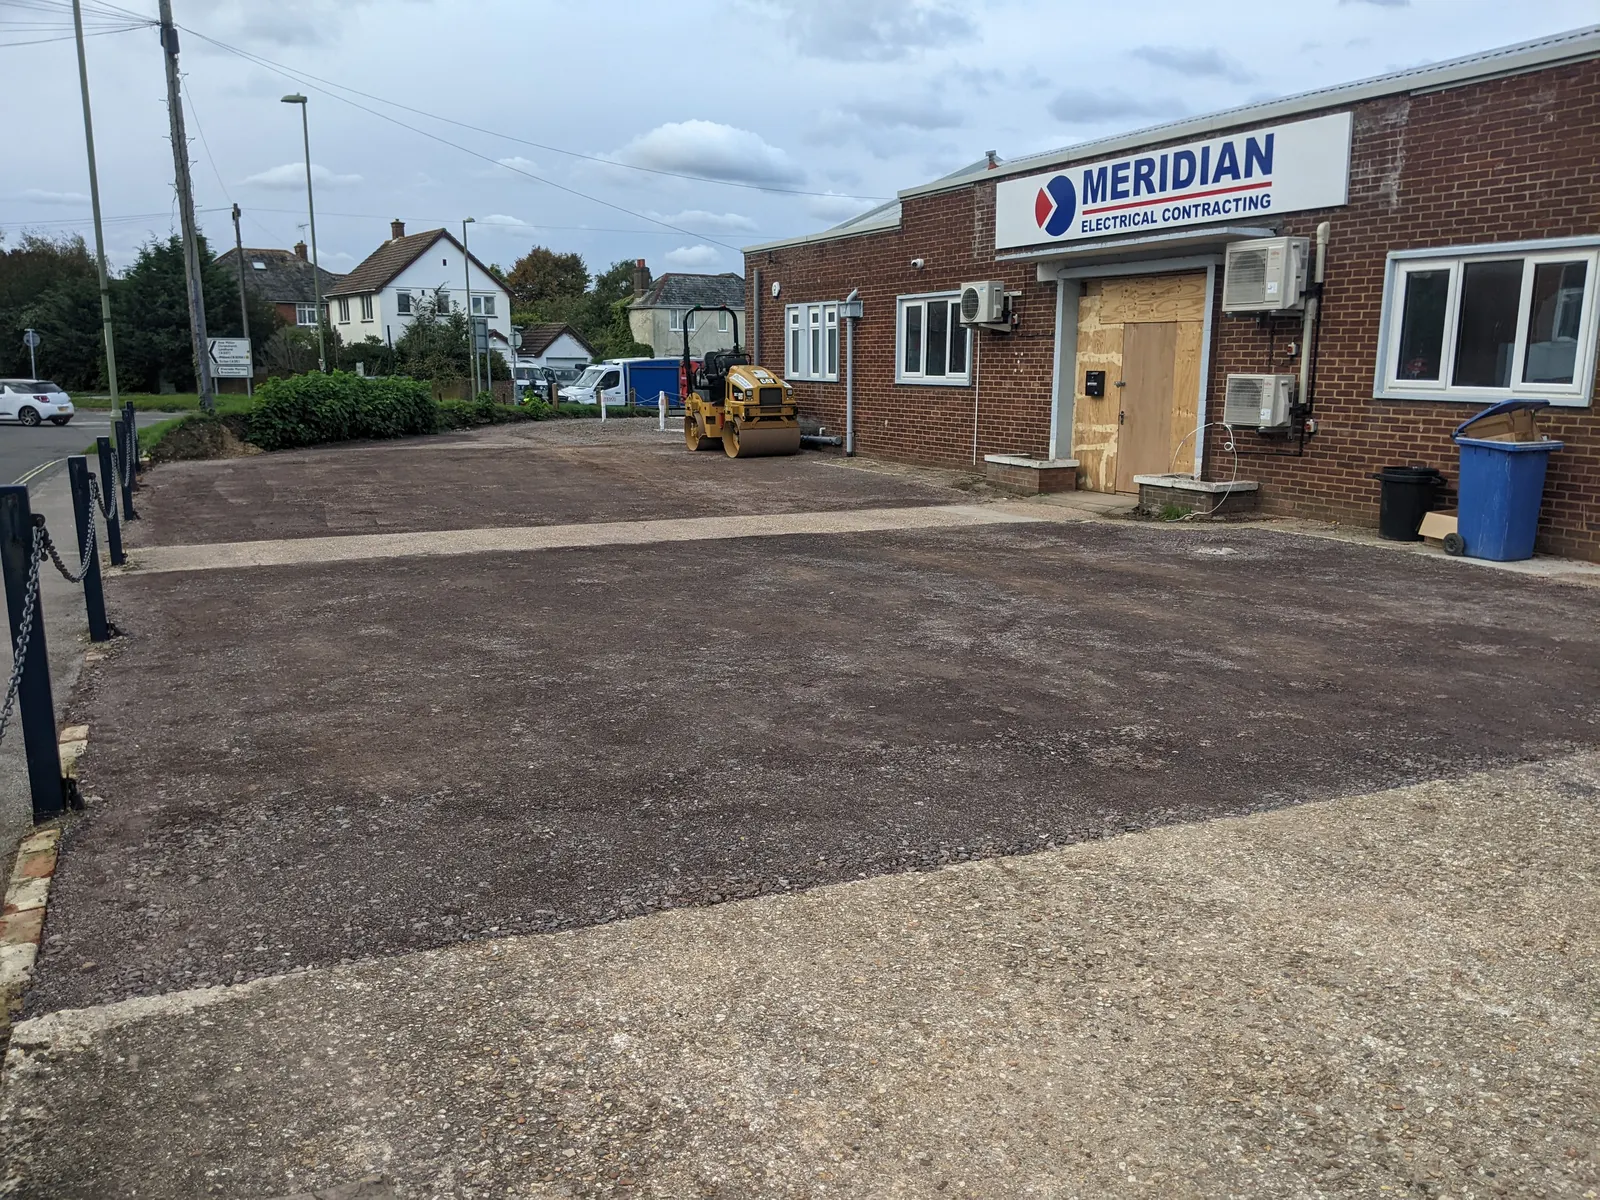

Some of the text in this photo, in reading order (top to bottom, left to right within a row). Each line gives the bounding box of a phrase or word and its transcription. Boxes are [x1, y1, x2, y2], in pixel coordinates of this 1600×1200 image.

[1082, 132, 1275, 206] MERIDIAN
[1081, 193, 1271, 233] ELECTRICAL CONTRACTING
